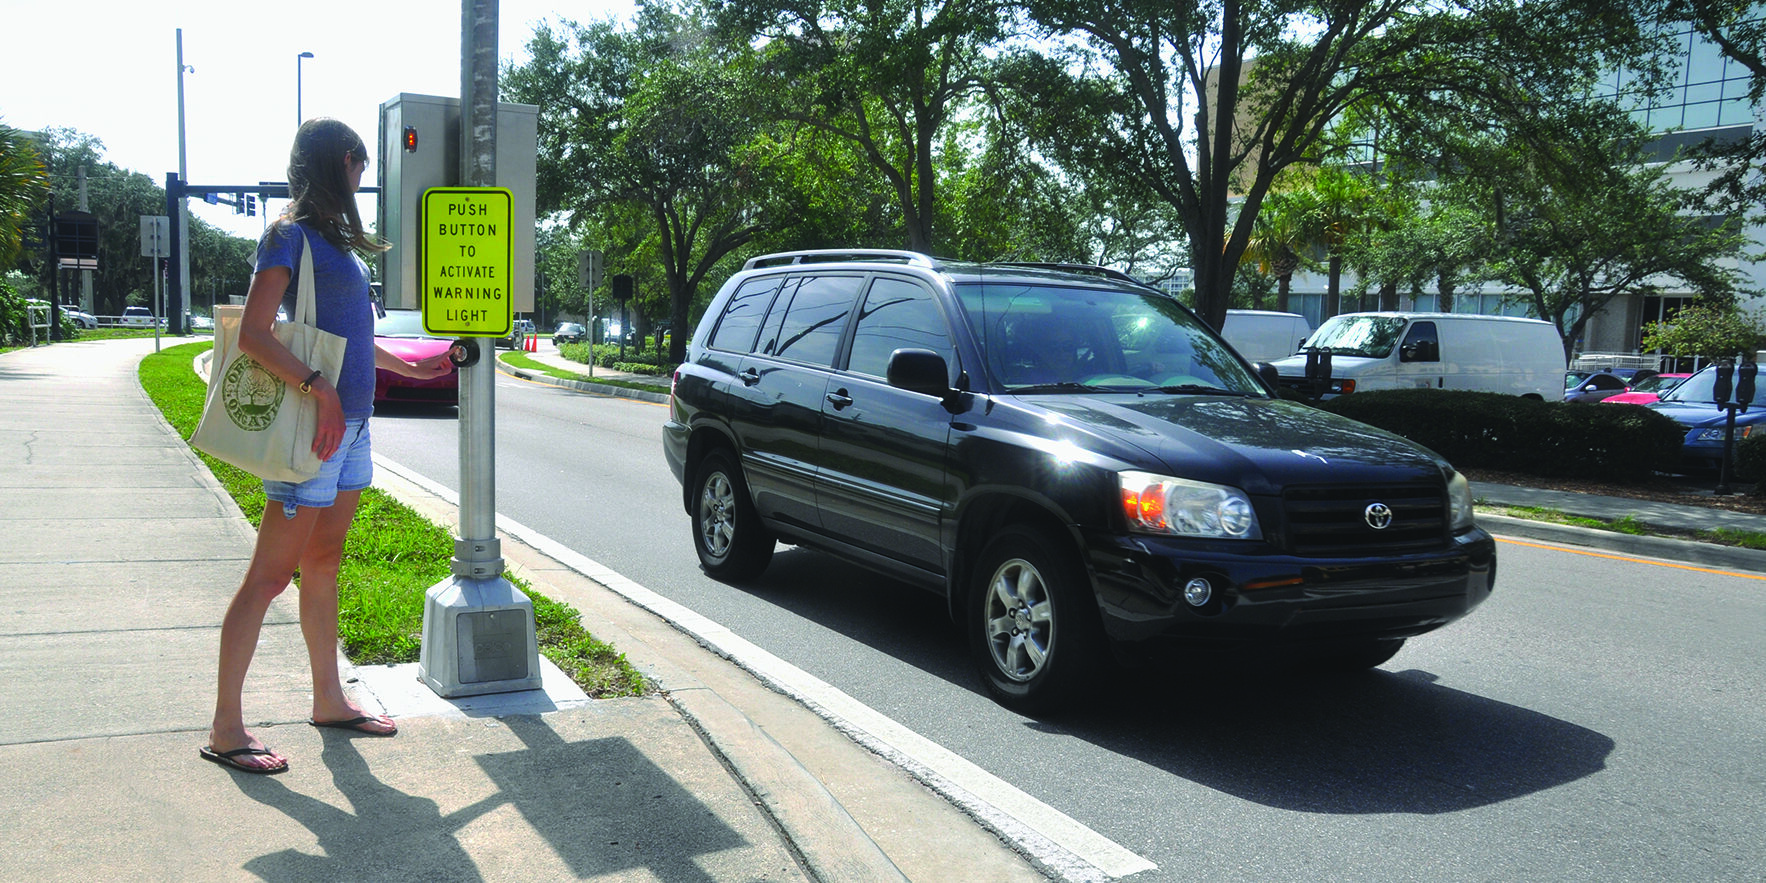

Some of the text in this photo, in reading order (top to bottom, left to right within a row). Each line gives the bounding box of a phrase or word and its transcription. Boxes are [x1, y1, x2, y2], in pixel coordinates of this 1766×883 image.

[448, 204, 487, 216] PUSH
[439, 224, 496, 236] BUTTON
[459, 245, 476, 257] TO
[440, 266, 495, 278] ACTIVATE
[433, 287, 501, 300] WARNING
[446, 309, 488, 322] LIGHT
